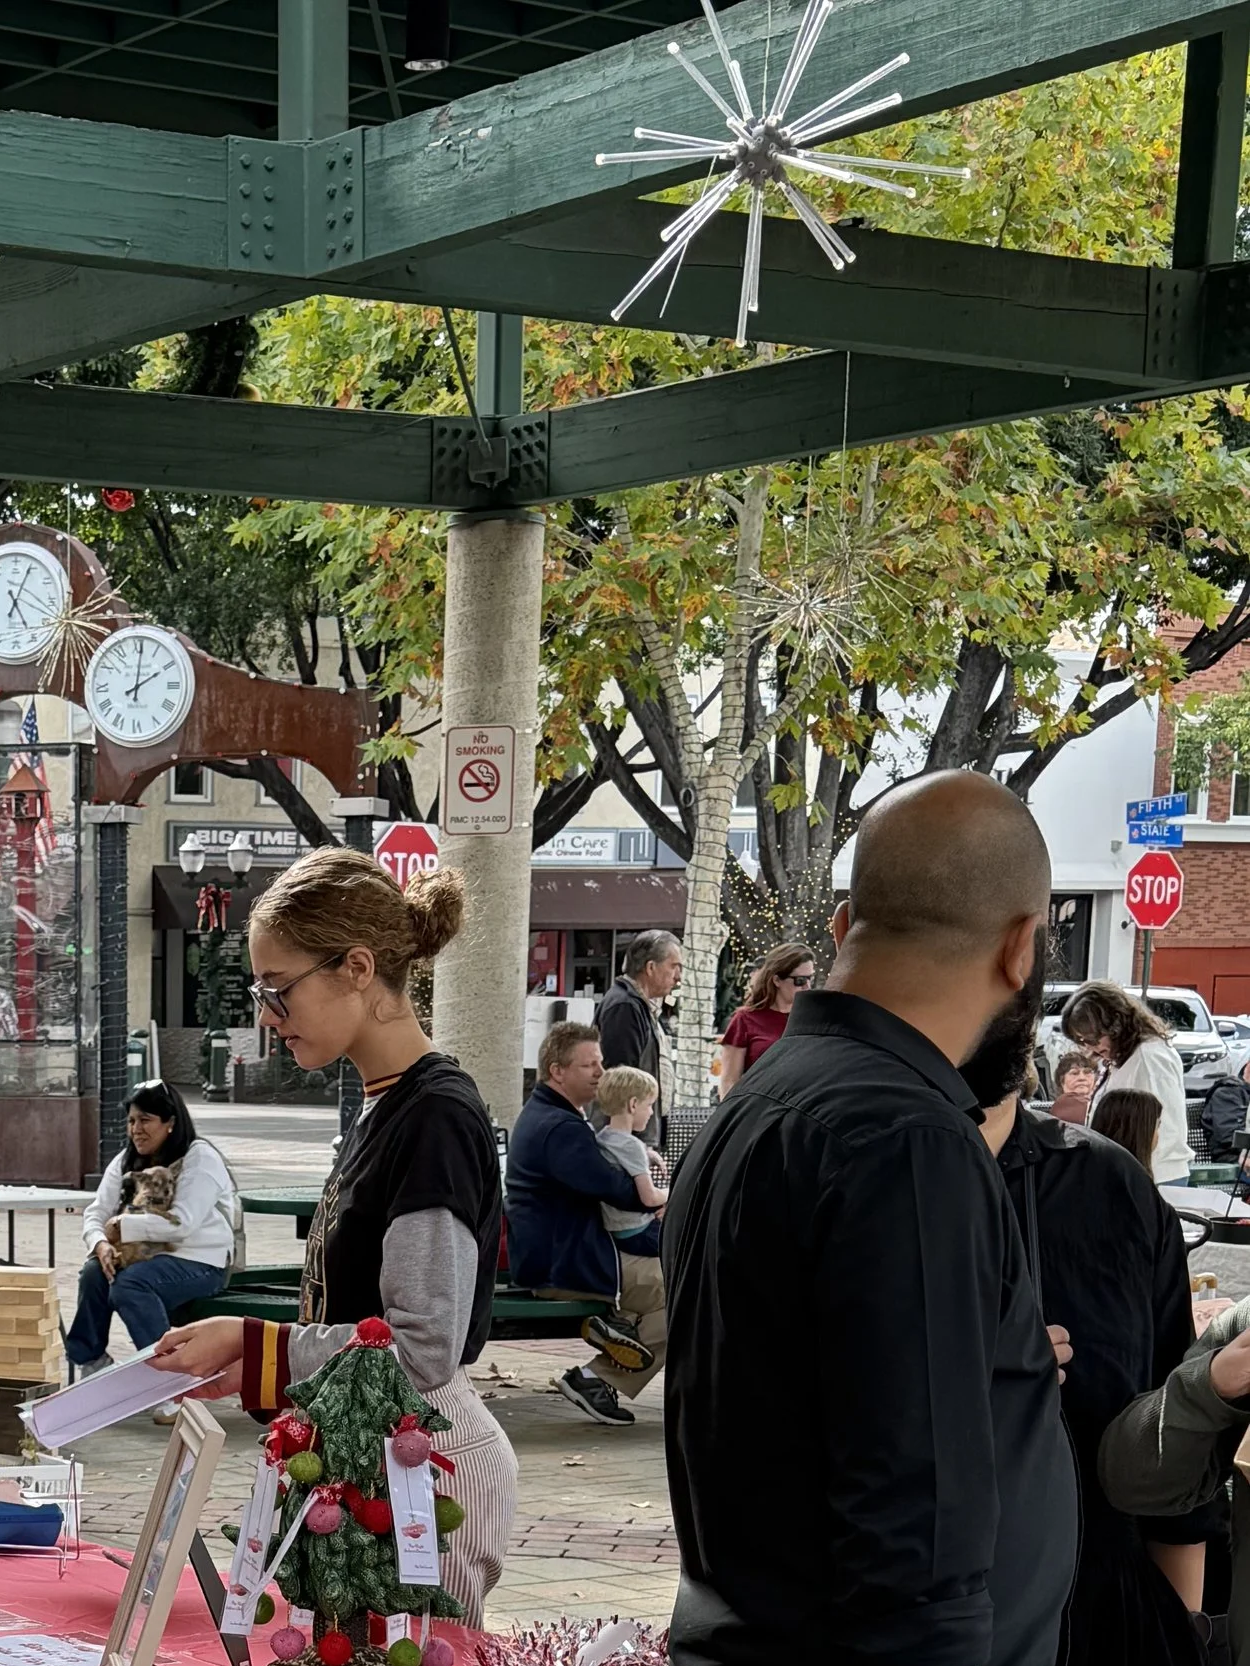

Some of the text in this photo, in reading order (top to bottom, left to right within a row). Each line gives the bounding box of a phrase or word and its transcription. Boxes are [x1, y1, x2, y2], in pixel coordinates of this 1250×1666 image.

[473, 734, 489, 745] NO
[455, 744, 506, 757] SMOKING
[1138, 796, 1172, 814] FIFTH
[1140, 823, 1171, 837] STATE
[196, 829, 235, 844] BIG
[238, 831, 297, 846] TIME
[585, 849, 603, 857] Food
[1129, 874, 1180, 905] STOP
